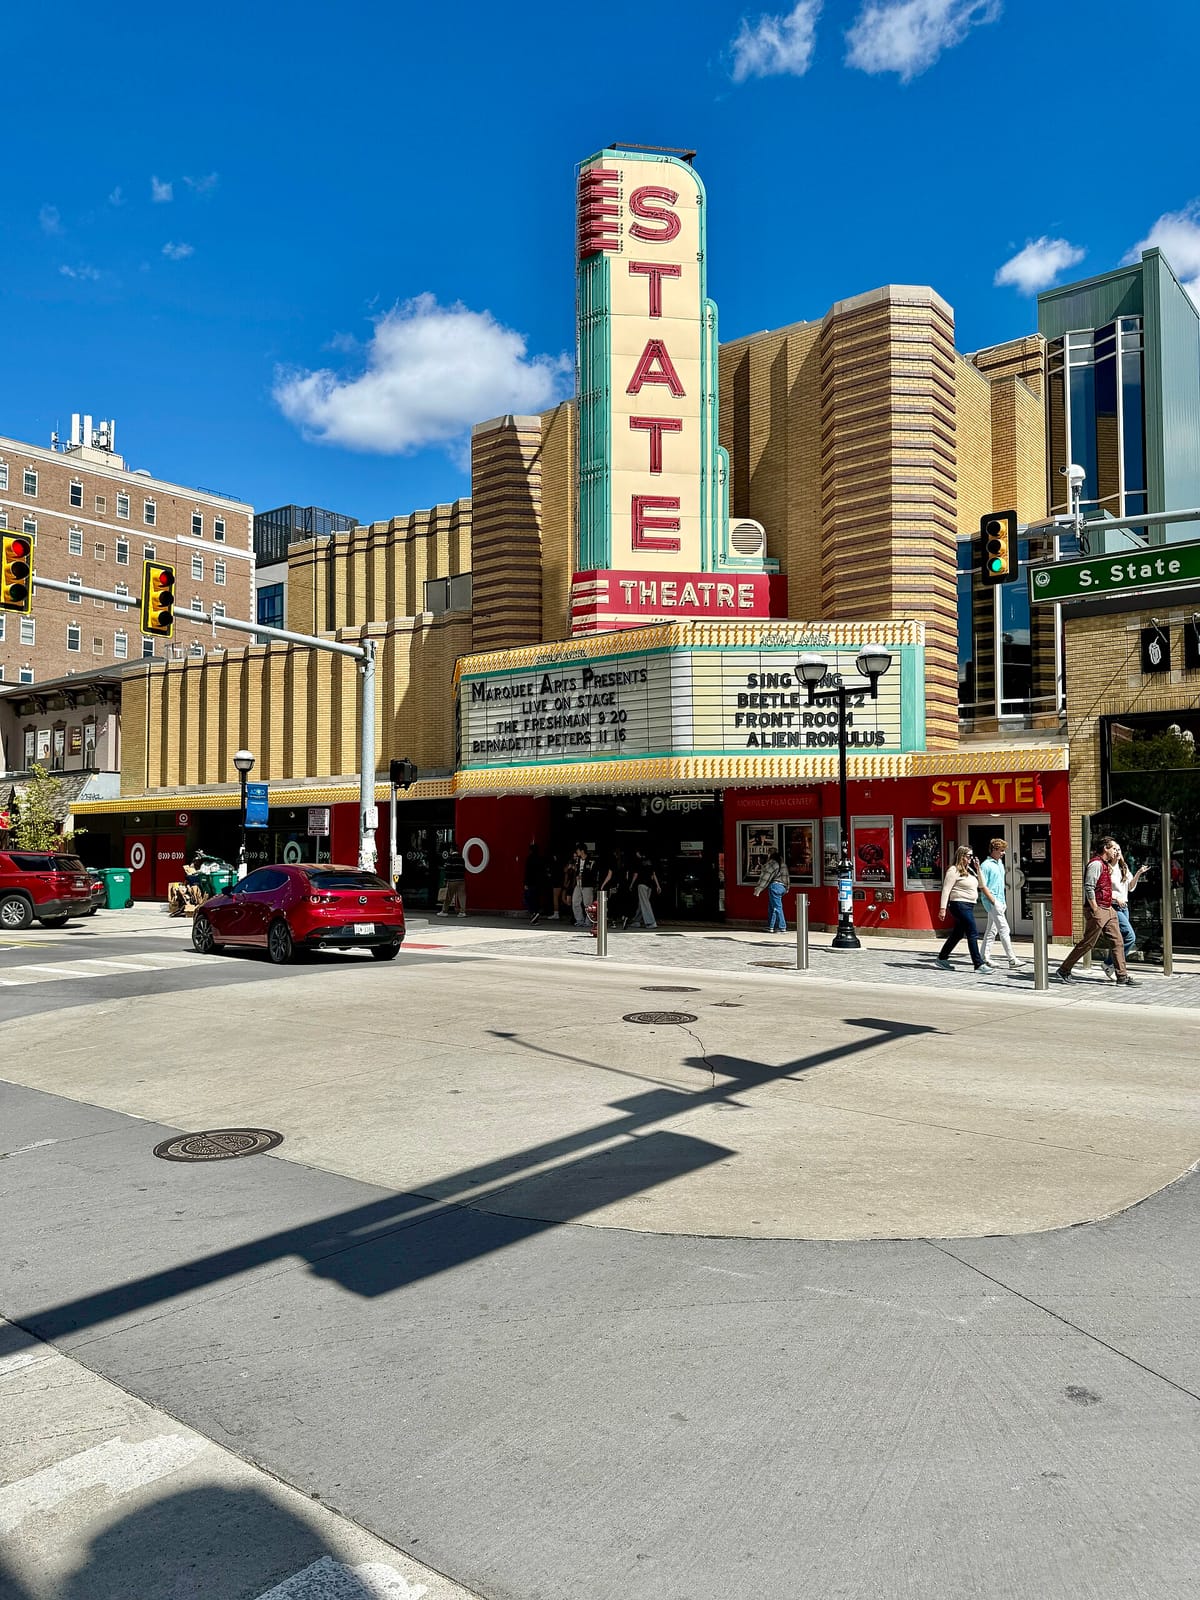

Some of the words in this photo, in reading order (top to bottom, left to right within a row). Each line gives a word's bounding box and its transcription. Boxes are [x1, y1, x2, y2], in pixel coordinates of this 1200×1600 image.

[627, 185, 685, 553] STATE
[1079, 570, 1099, 586] S.
[1110, 558, 1181, 582] State
[619, 581, 754, 608] THEATRE
[472, 681, 534, 702] MARQUEE
[540, 674, 577, 695] ARTS
[582, 668, 648, 690] PRESENTS
[747, 673, 792, 689] SING
[522, 700, 548, 714] LIVE
[554, 697, 571, 711] ON
[577, 692, 617, 708] STAGE
[737, 693, 800, 708] BEETLE
[496, 720, 519, 735] THE
[524, 713, 590, 732] FRESHMAN
[610, 709, 627, 724] 20
[735, 712, 795, 728] FRONT
[472, 735, 542, 753] BERNADETTE
[547, 731, 592, 748] PETERS
[599, 729, 608, 744] 11
[614, 727, 627, 743] 16
[746, 731, 800, 747] ALIEN
[806, 731, 885, 747] ROMULUS
[931, 777, 1034, 806] STATE
[666, 799, 703, 814] target
